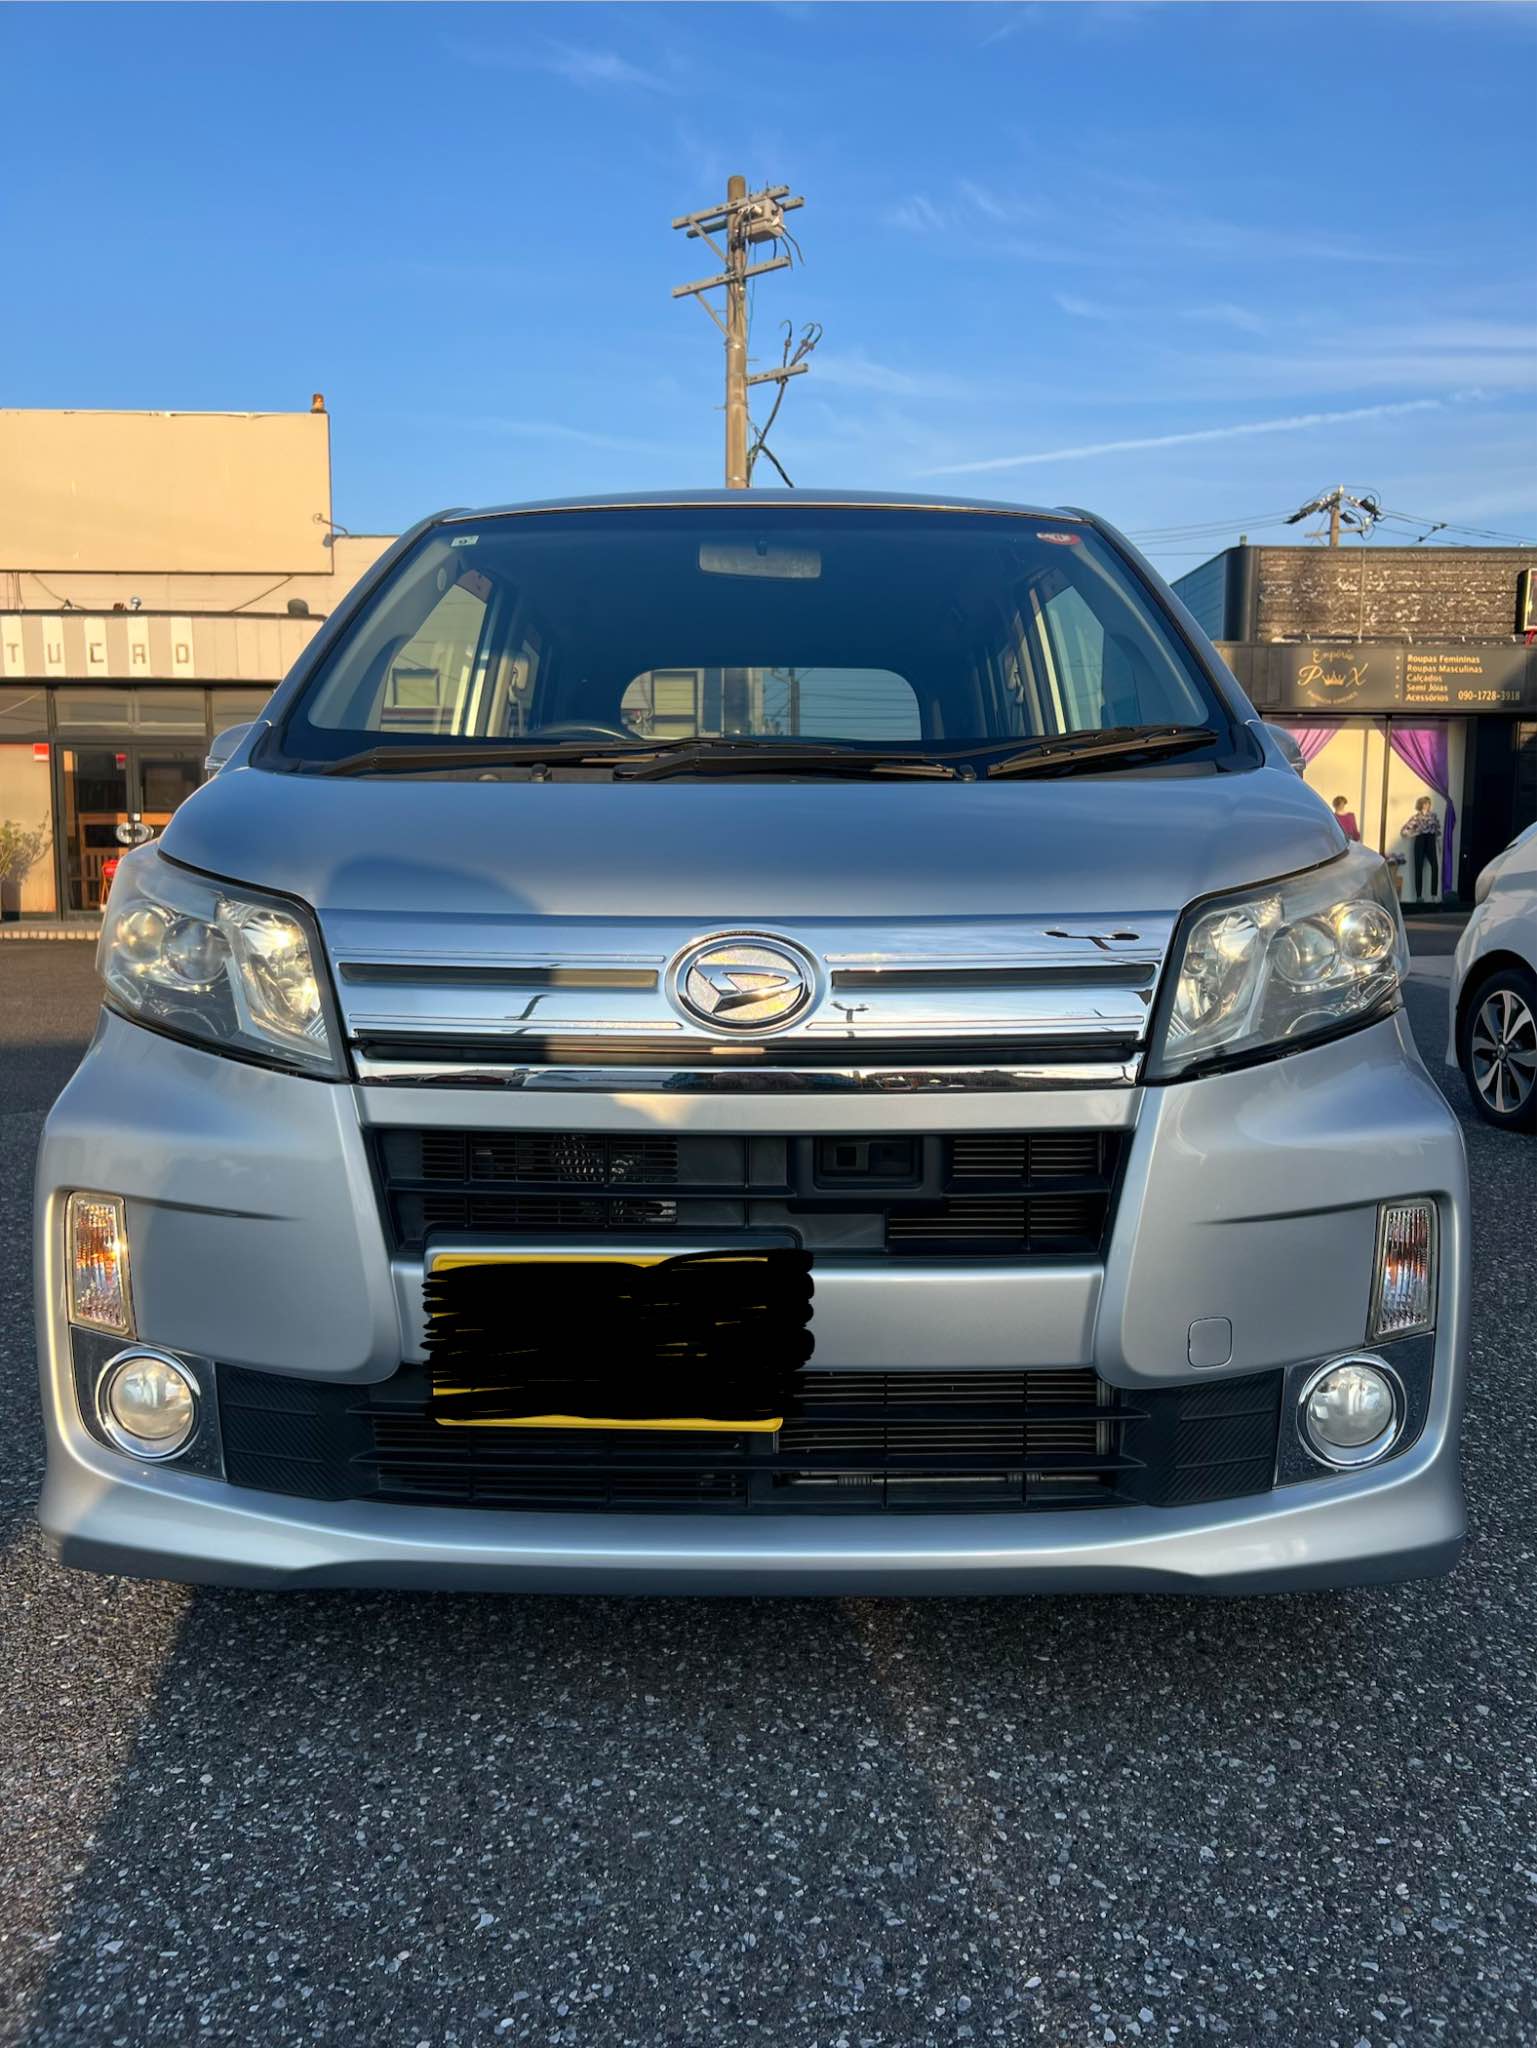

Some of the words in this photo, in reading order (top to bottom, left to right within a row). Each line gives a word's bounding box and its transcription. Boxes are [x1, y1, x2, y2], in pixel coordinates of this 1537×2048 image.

[1407, 654, 1437, 664] Roupas
[1439, 655, 1480, 664] Femininas
[1407, 665, 1437, 673] Roupas
[1438, 665, 1483, 673] Masculinas
[1406, 674, 1443, 682] Calçados
[1406, 684, 1426, 692] Semi
[1405, 693, 1449, 702] Acessórios
